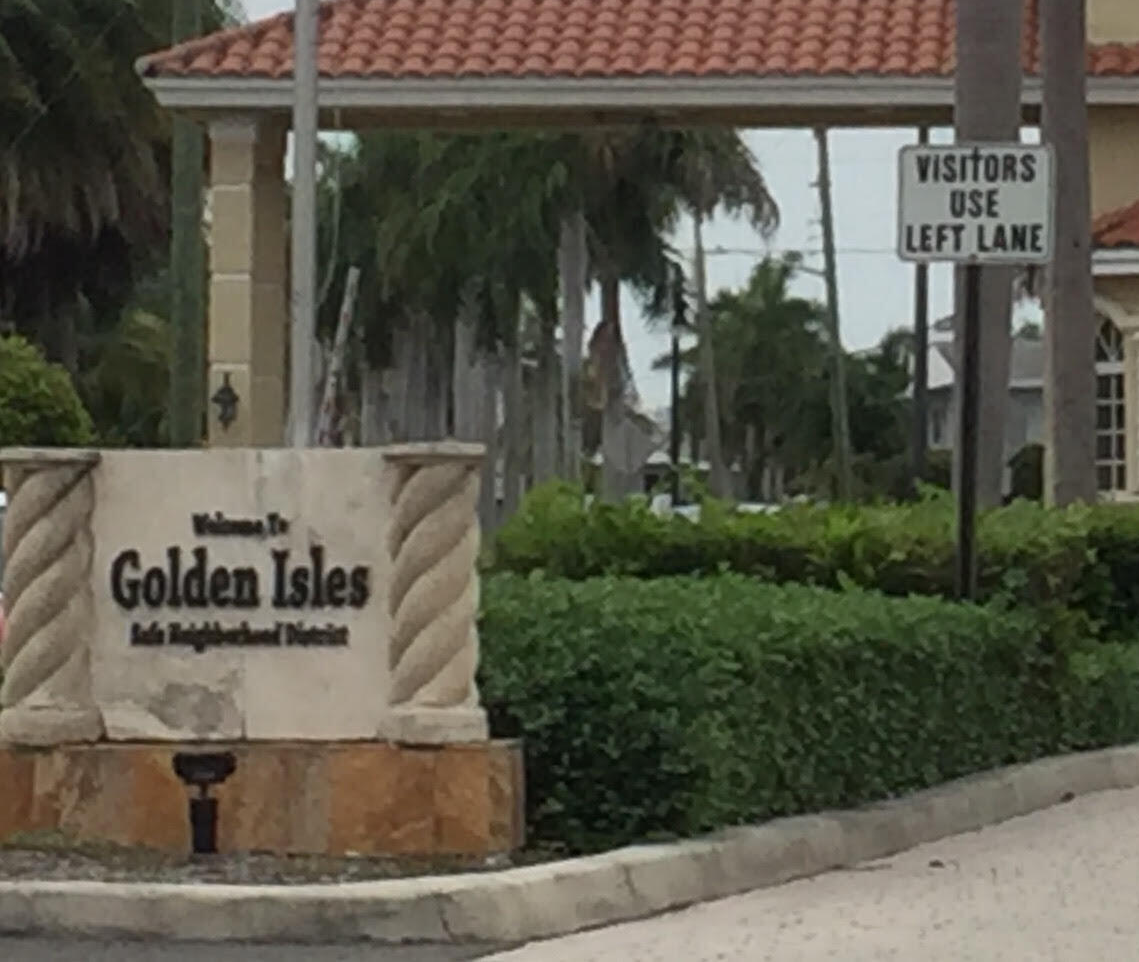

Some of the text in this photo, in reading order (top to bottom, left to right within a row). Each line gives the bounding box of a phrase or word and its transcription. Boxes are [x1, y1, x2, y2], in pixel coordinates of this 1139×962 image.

[916, 153, 1037, 183] VISITORS
[950, 189, 1000, 218] USE
[905, 224, 1044, 253] LEFT LANE
[111, 545, 370, 609] Golden Isles
